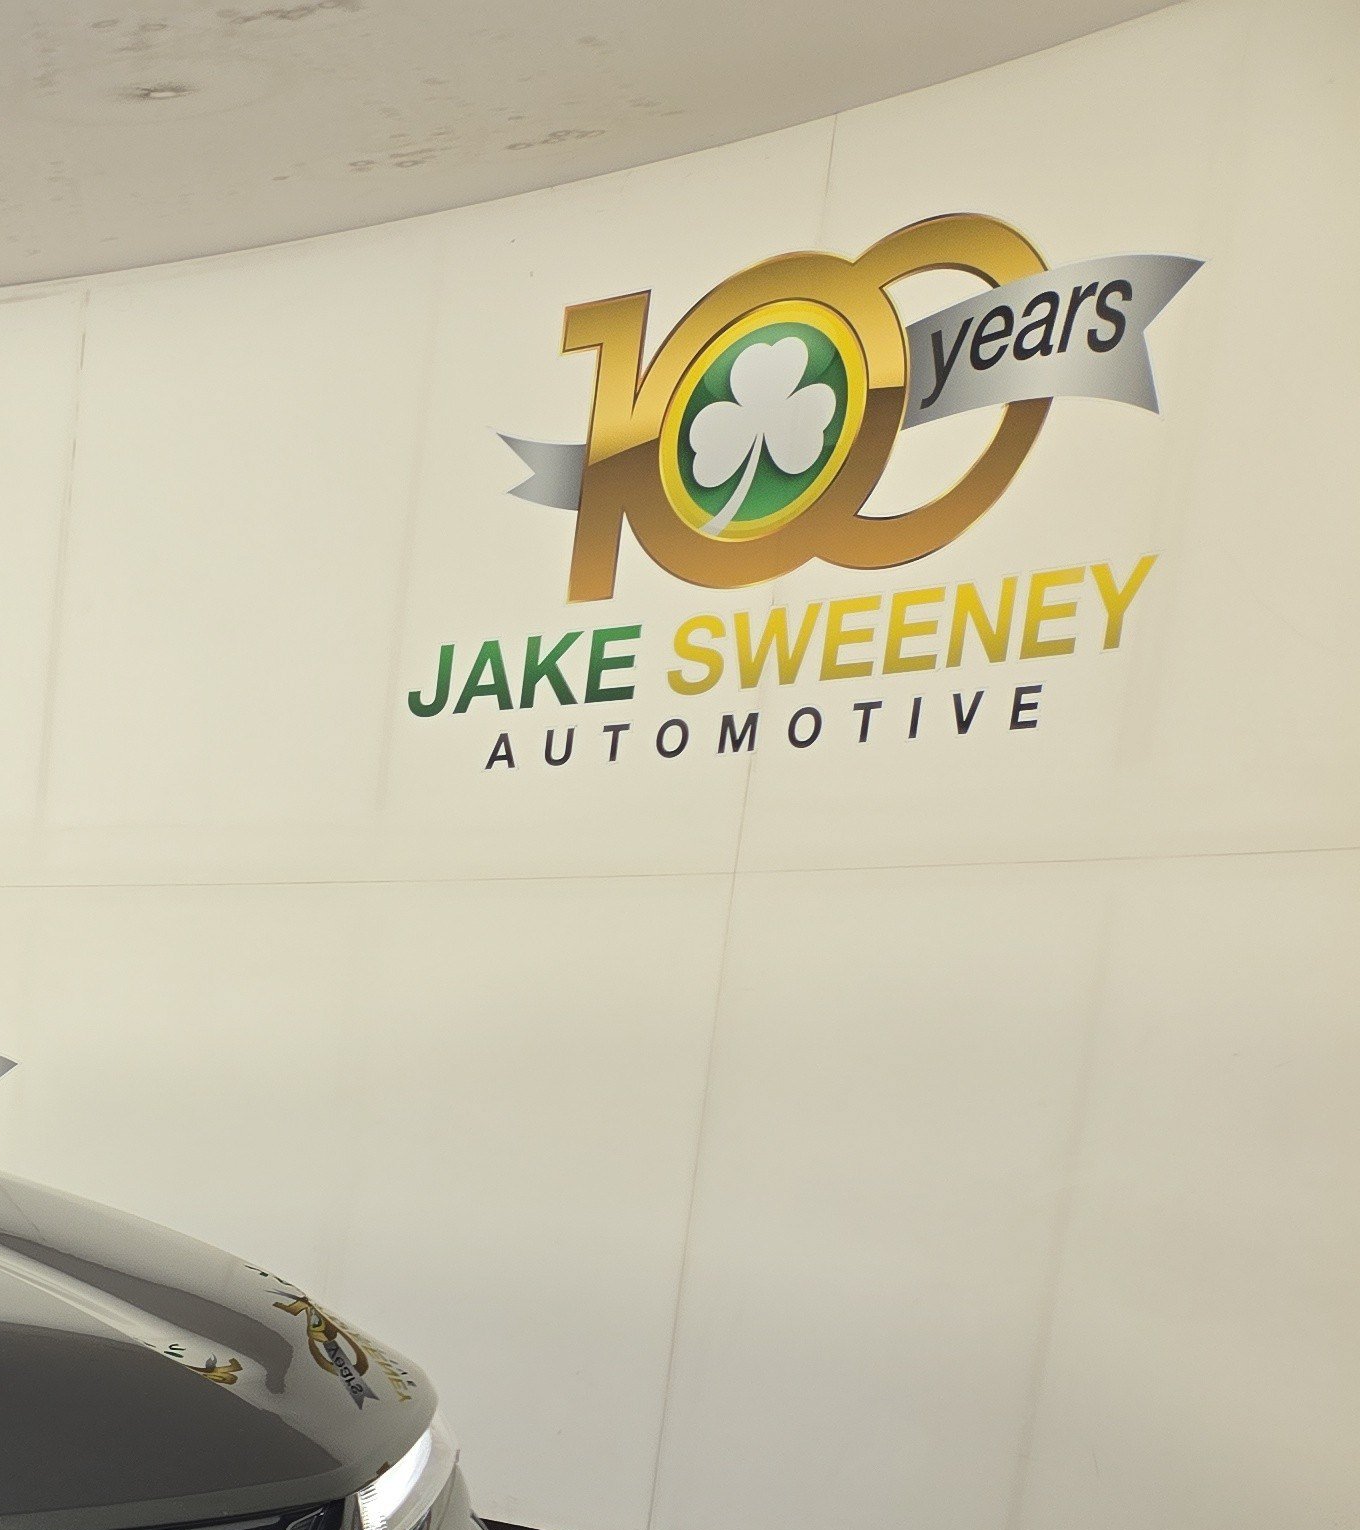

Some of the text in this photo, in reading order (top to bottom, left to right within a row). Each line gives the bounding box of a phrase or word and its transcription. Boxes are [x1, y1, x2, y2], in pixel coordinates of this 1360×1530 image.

[561, 212, 1054, 605] 100
[920, 278, 1134, 409] years
[407, 554, 1159, 719] JAKE SWEENEY
[485, 684, 1044, 772] AUTOMOTIVE
